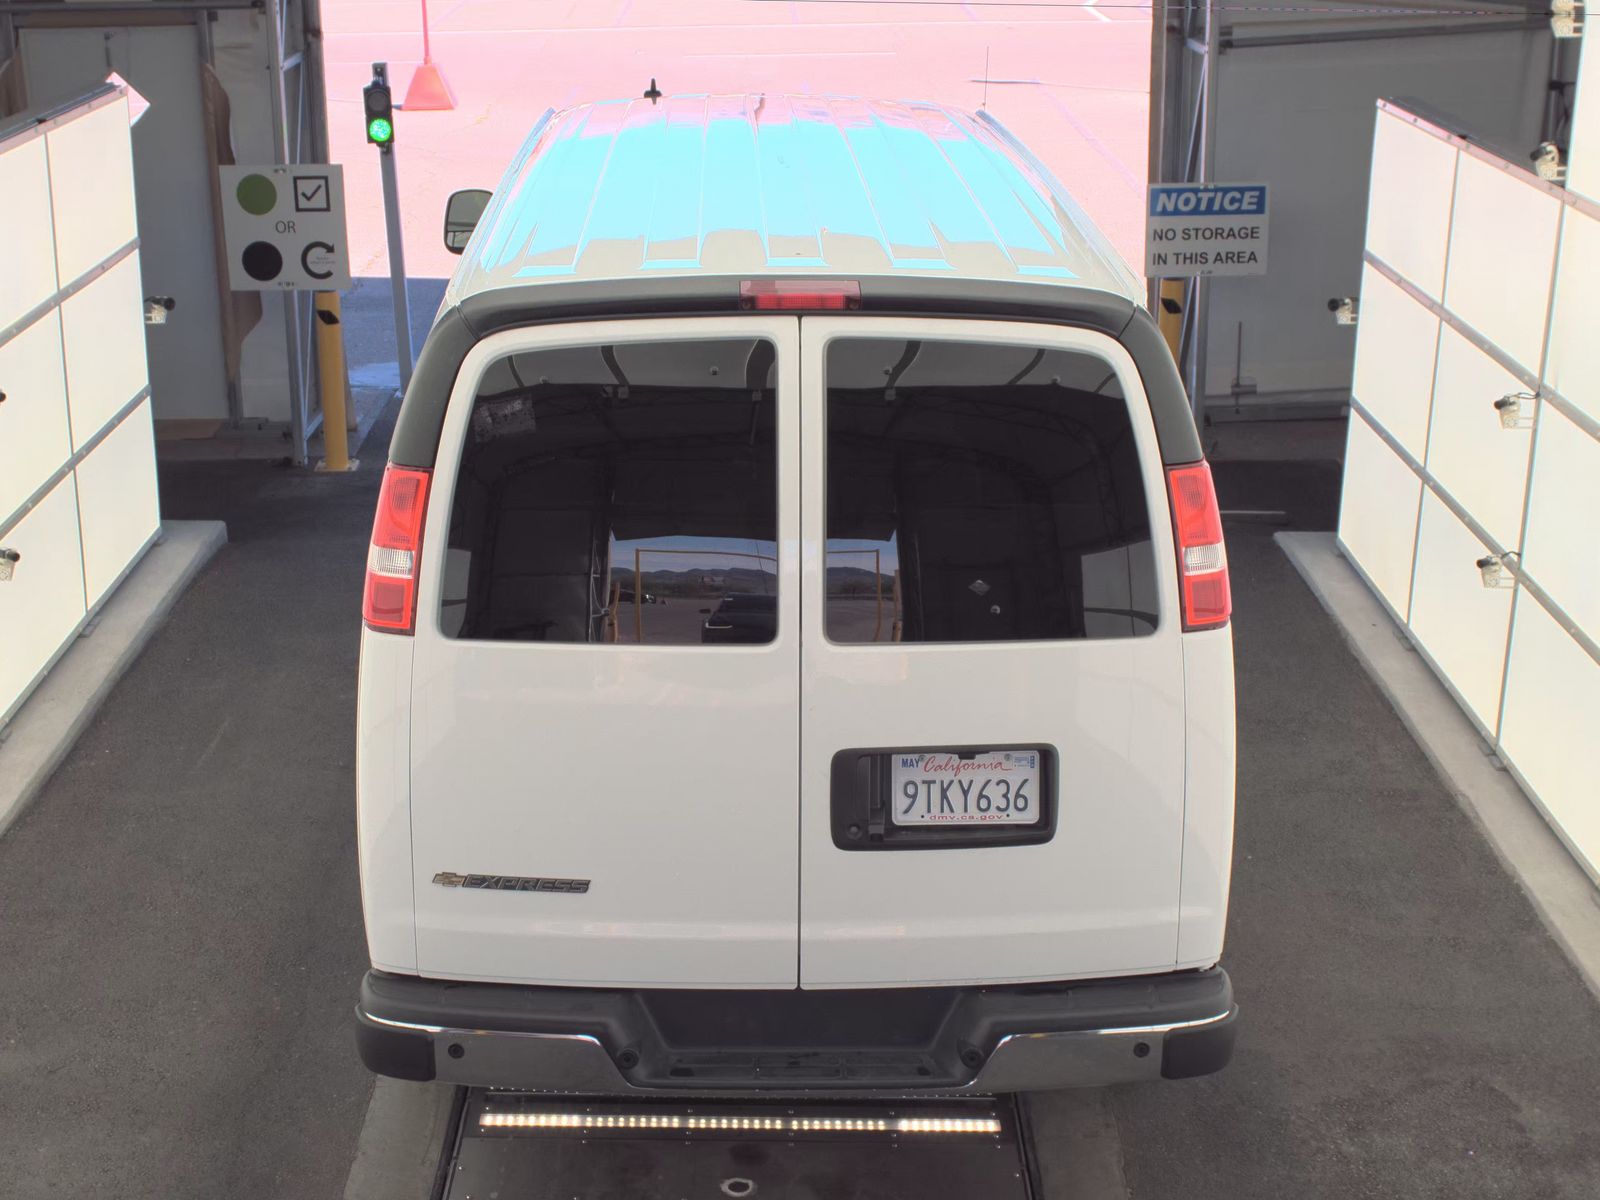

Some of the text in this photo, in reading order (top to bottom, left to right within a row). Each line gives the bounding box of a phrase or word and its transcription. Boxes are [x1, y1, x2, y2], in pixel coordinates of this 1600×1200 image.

[1156, 191, 1260, 212] NOTICE
[275, 220, 296, 234] OR
[1152, 226, 1260, 241] NO STORAGE
[1152, 251, 1258, 265] IN THIS AREA
[901, 757, 920, 769] MAY
[923, 755, 1013, 777] California
[902, 778, 1029, 815] 9TKY636
[929, 813, 1004, 822] dmv.ca.gov
[462, 874, 591, 893] EXPRESS
